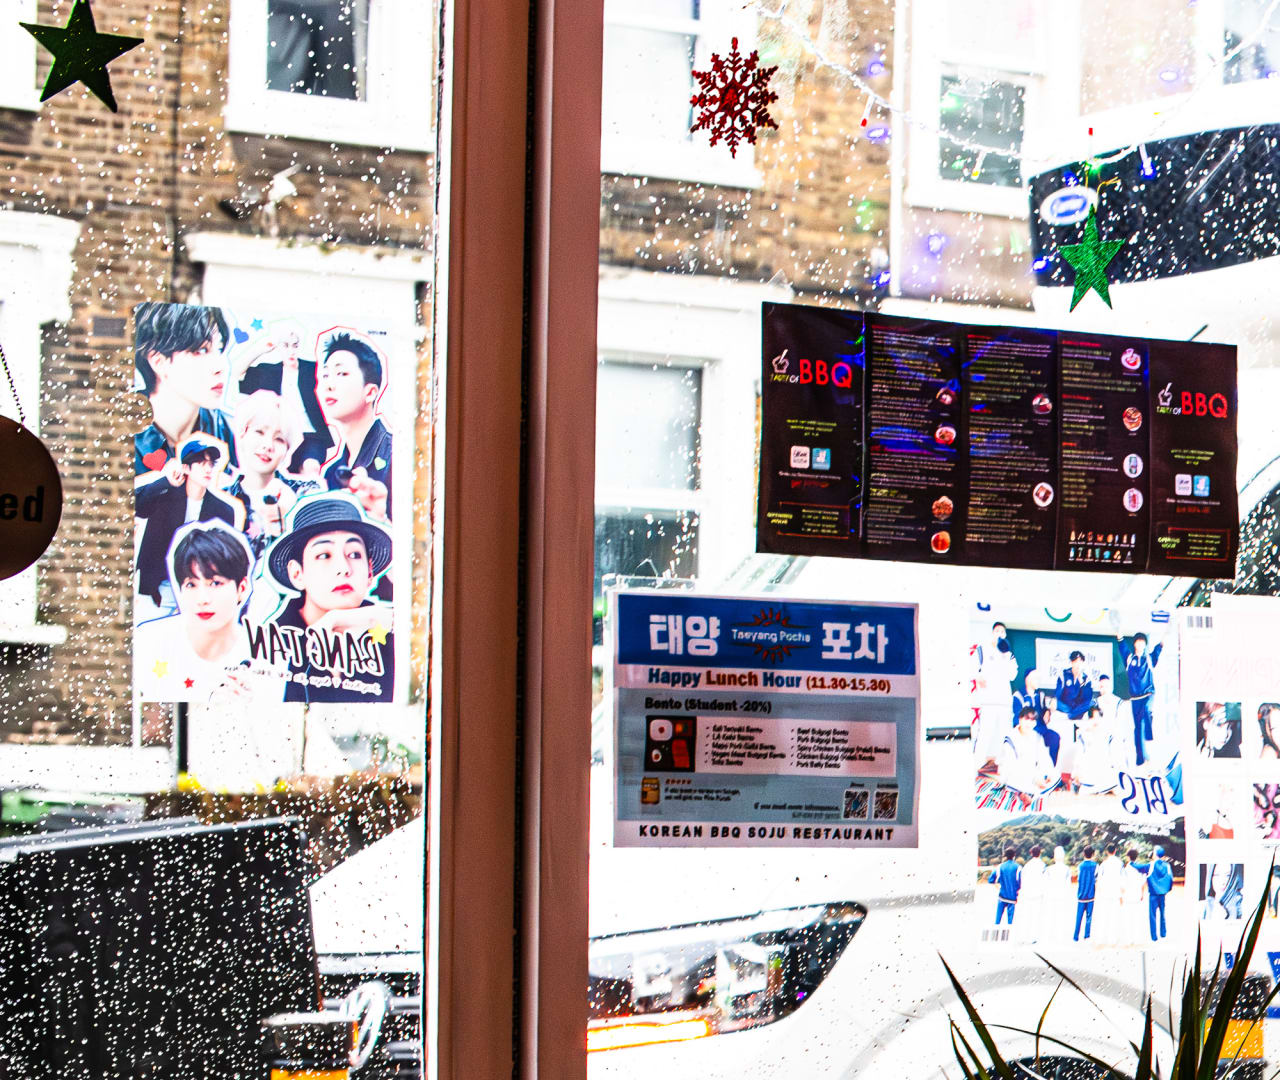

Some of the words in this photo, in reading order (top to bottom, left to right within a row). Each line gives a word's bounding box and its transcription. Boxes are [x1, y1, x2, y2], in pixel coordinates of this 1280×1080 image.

[799, 359, 852, 389] BBQ
[1181, 391, 1228, 418] BBQ
[650, 615, 720, 656] 태양
[732, 629, 777, 643] Taeyang
[780, 630, 810, 643] Pocha
[821, 622, 888, 663] 포차
[648, 668, 701, 687] Happy
[706, 670, 758, 686] Lunch
[763, 672, 802, 688] Hour
[806, 676, 891, 693] (11.30-15.30)
[645, 697, 682, 709] Bento
[685, 698, 737, 711] (Student
[739, 701, 772, 713] -20%)
[639, 825, 702, 837] KOREAN
[711, 826, 741, 838] BBQ
[748, 826, 786, 838] SOJU
[793, 827, 894, 840] RESTAURANT
